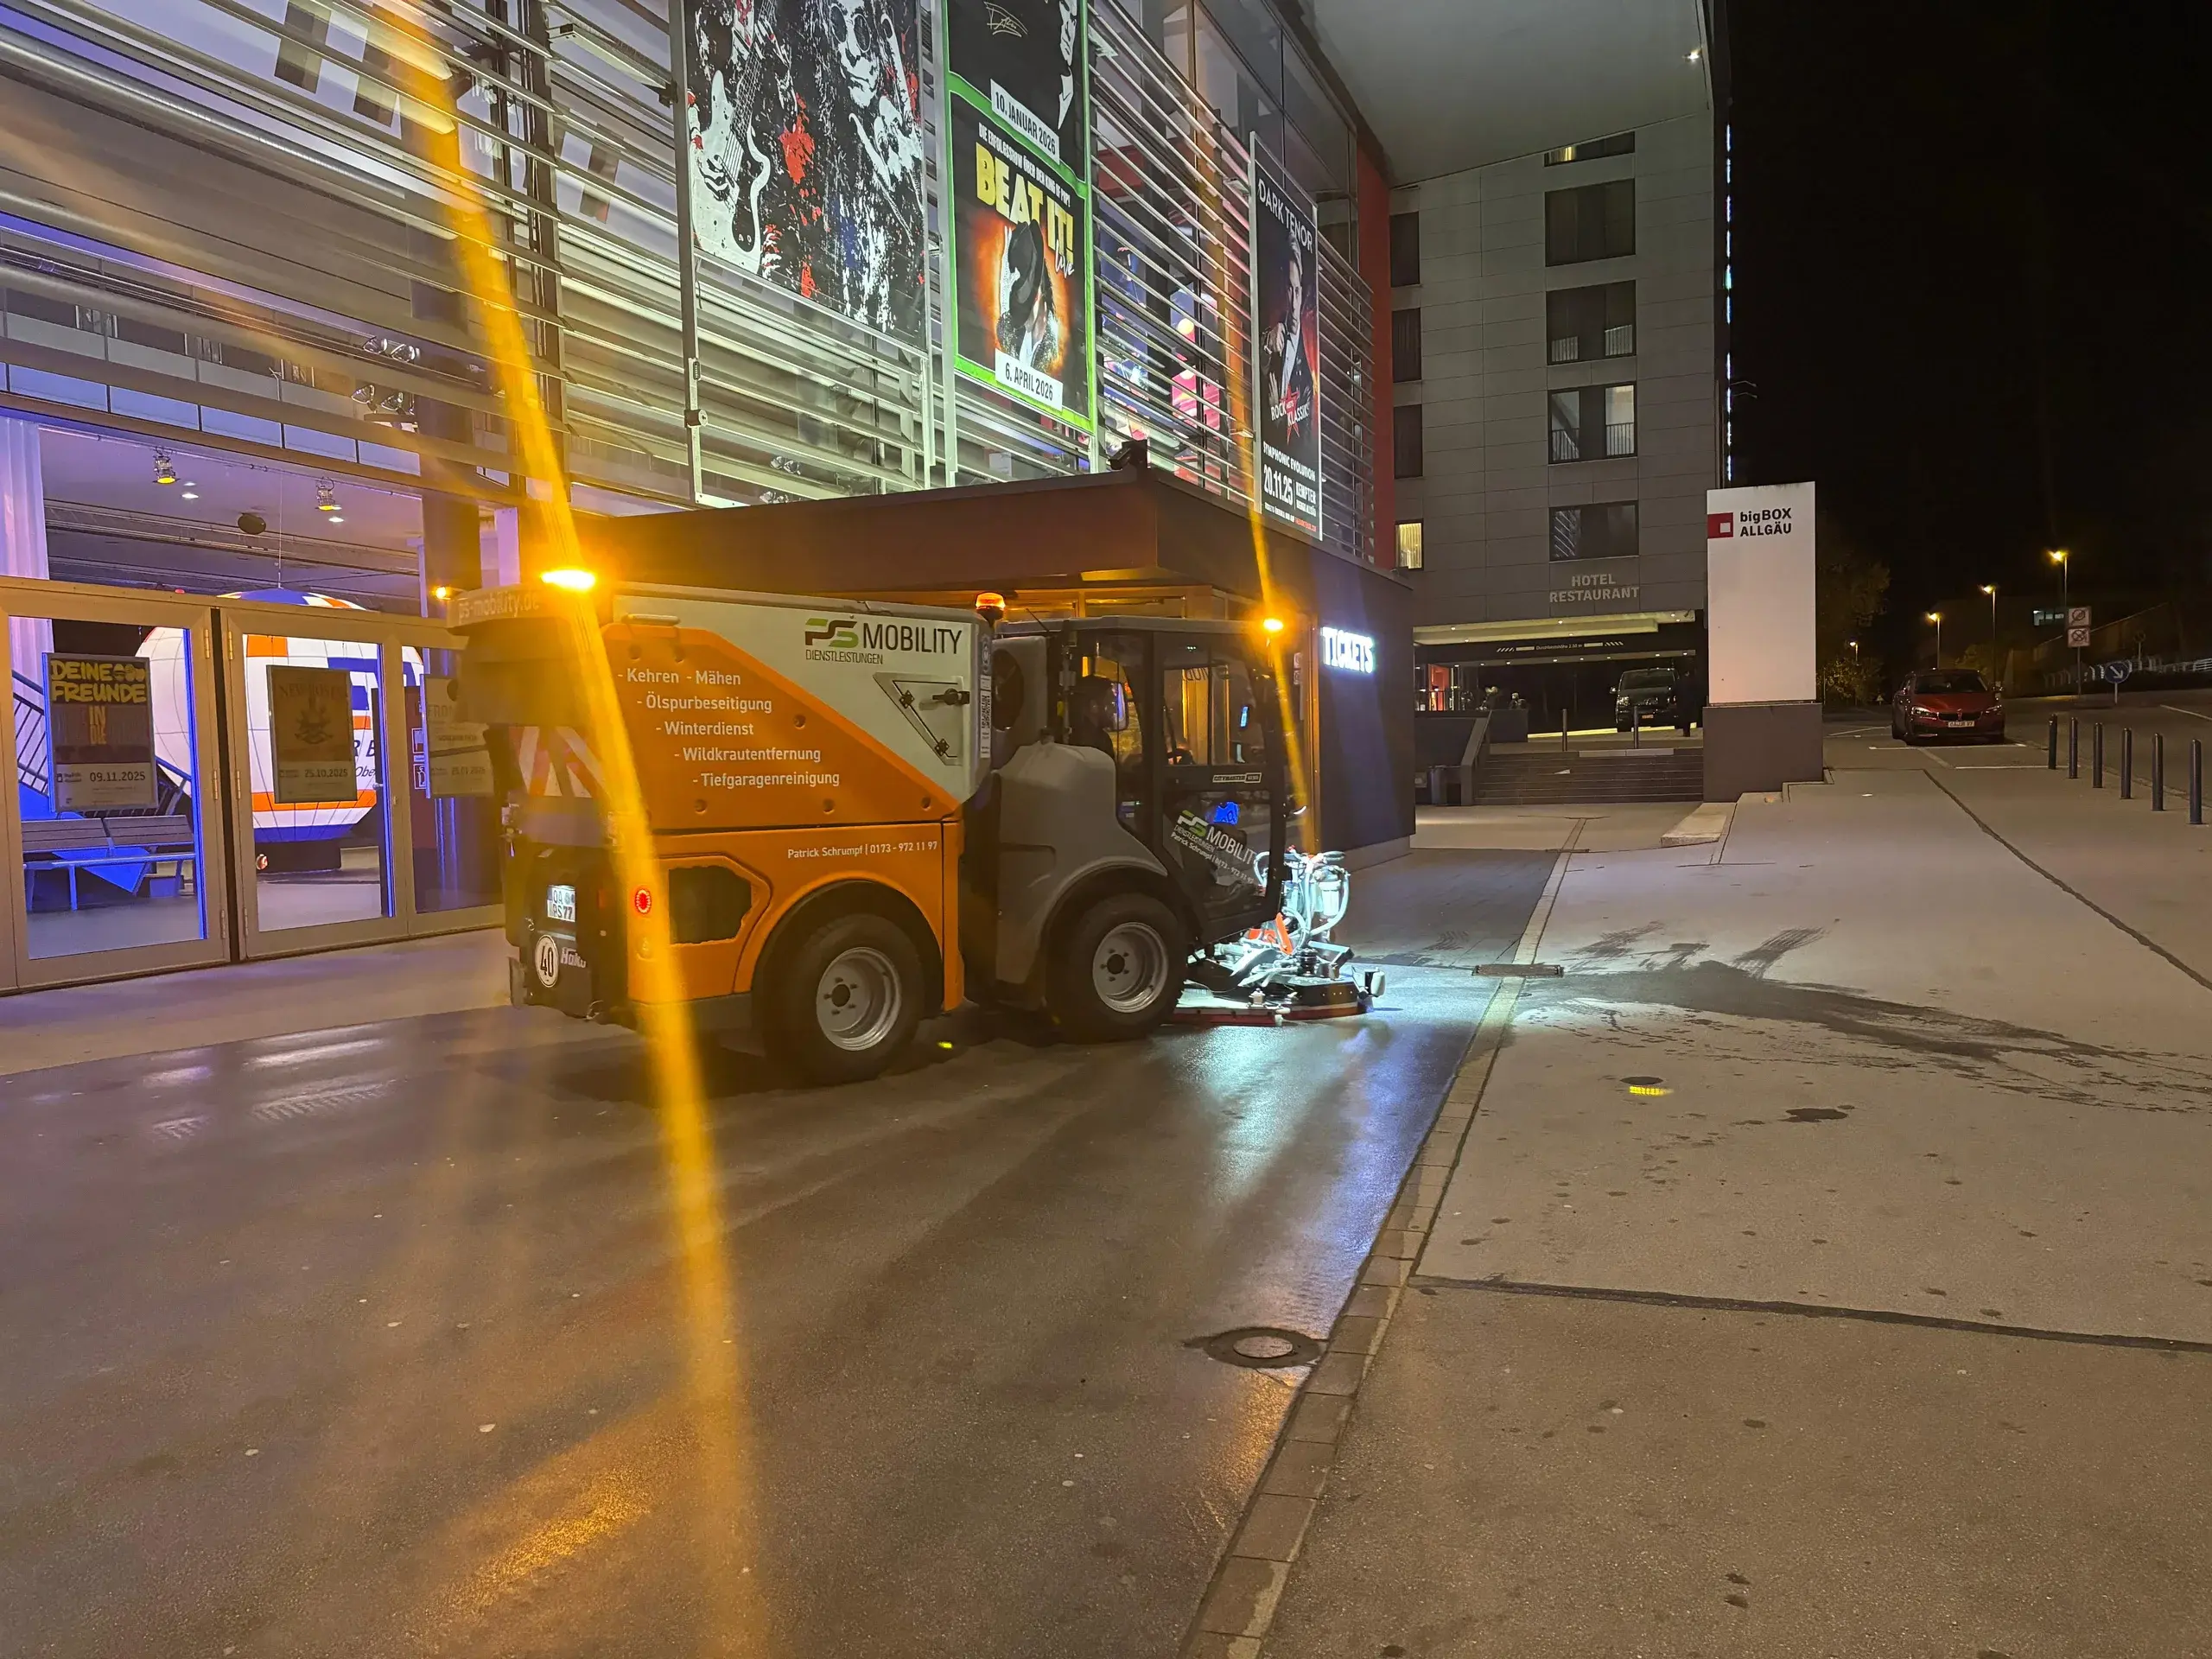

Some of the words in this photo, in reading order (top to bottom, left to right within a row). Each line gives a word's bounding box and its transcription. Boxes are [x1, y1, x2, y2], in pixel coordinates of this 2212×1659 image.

[978, 122, 988, 142] DIE
[995, 92, 1007, 116] 10.
[1008, 101, 1037, 140] JANUAR
[1039, 127, 1056, 156] 2026
[976, 142, 1043, 226] BEAT
[1046, 195, 1074, 265] IT!
[1258, 178, 1284, 224] DARK
[1285, 206, 1313, 254] TENOR
[1005, 362, 1013, 382] 6.
[1014, 366, 1034, 392] APRIL
[1035, 378, 1053, 402] 2026
[1270, 400, 1287, 421] ROCK
[1263, 441, 1290, 468] SYMPHONIC
[1290, 457, 1316, 482] EVOLUTION
[1263, 463, 1294, 505] 20.11.25
[1739, 507, 1792, 524] bigBOX
[1739, 521, 1792, 537] ALLGÄU
[1572, 574, 1617, 587] HOTEL
[1549, 587, 1640, 603] RESTAURANT
[862, 622, 963, 654] MOBILITY
[805, 649, 883, 664] DIENSTLEISTUNGEN
[1320, 626, 1374, 674] TICKETS
[50, 660, 113, 681] DEINE
[626, 668, 679, 683] Kehren
[696, 670, 741, 685] Mähen
[51, 681, 147, 703] FREUNDE
[646, 692, 772, 714] Ölspurbeseitigung
[89, 706, 106, 725] IN
[664, 721, 754, 735] Winterdienst
[683, 747, 822, 763] Wildkrautentfernung
[90, 771, 146, 782] 09.11.2025
[304, 769, 348, 779] 25.10.2025
[355, 766, 377, 778] Obe
[701, 771, 840, 789] Tiefgaragenreinigung
[1171, 831, 1188, 847] Patrick
[1206, 826, 1259, 865] MOBILIT
[788, 849, 819, 859] Patrick
[822, 845, 863, 856] Schrumpf
[870, 843, 891, 854] 0173
[899, 842, 913, 852] 972
[917, 842, 925, 851] 11
[928, 841, 938, 850] 97
[540, 944, 554, 978] 40
